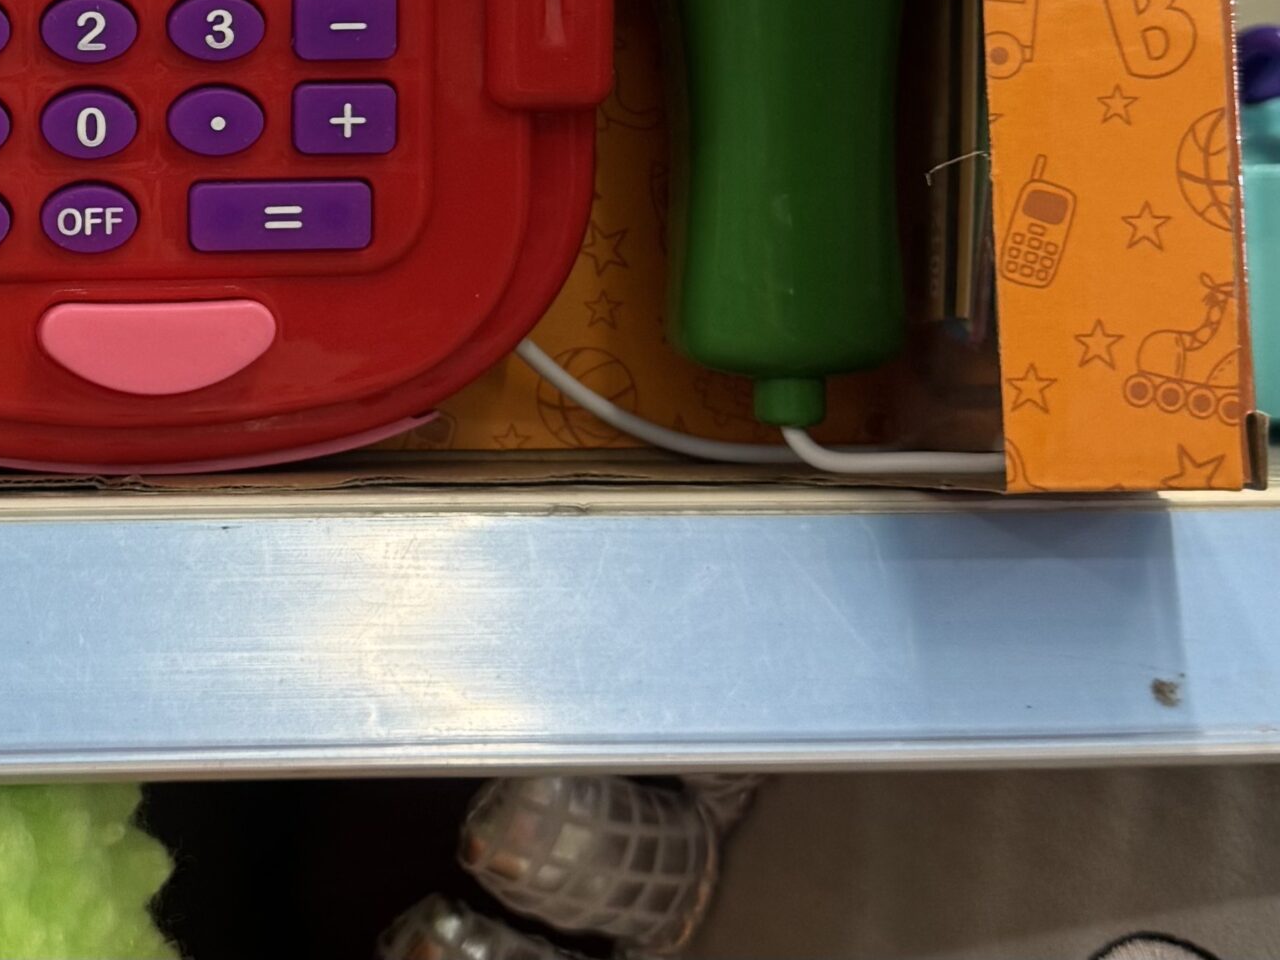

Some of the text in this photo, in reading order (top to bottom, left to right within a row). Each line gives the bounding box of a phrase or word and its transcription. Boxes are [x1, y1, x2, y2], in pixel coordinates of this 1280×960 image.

[76, 11, 106, 51] 2
[205, 9, 235, 49] 3
[75, 107, 107, 148] 0
[56, 206, 124, 236] OFF
